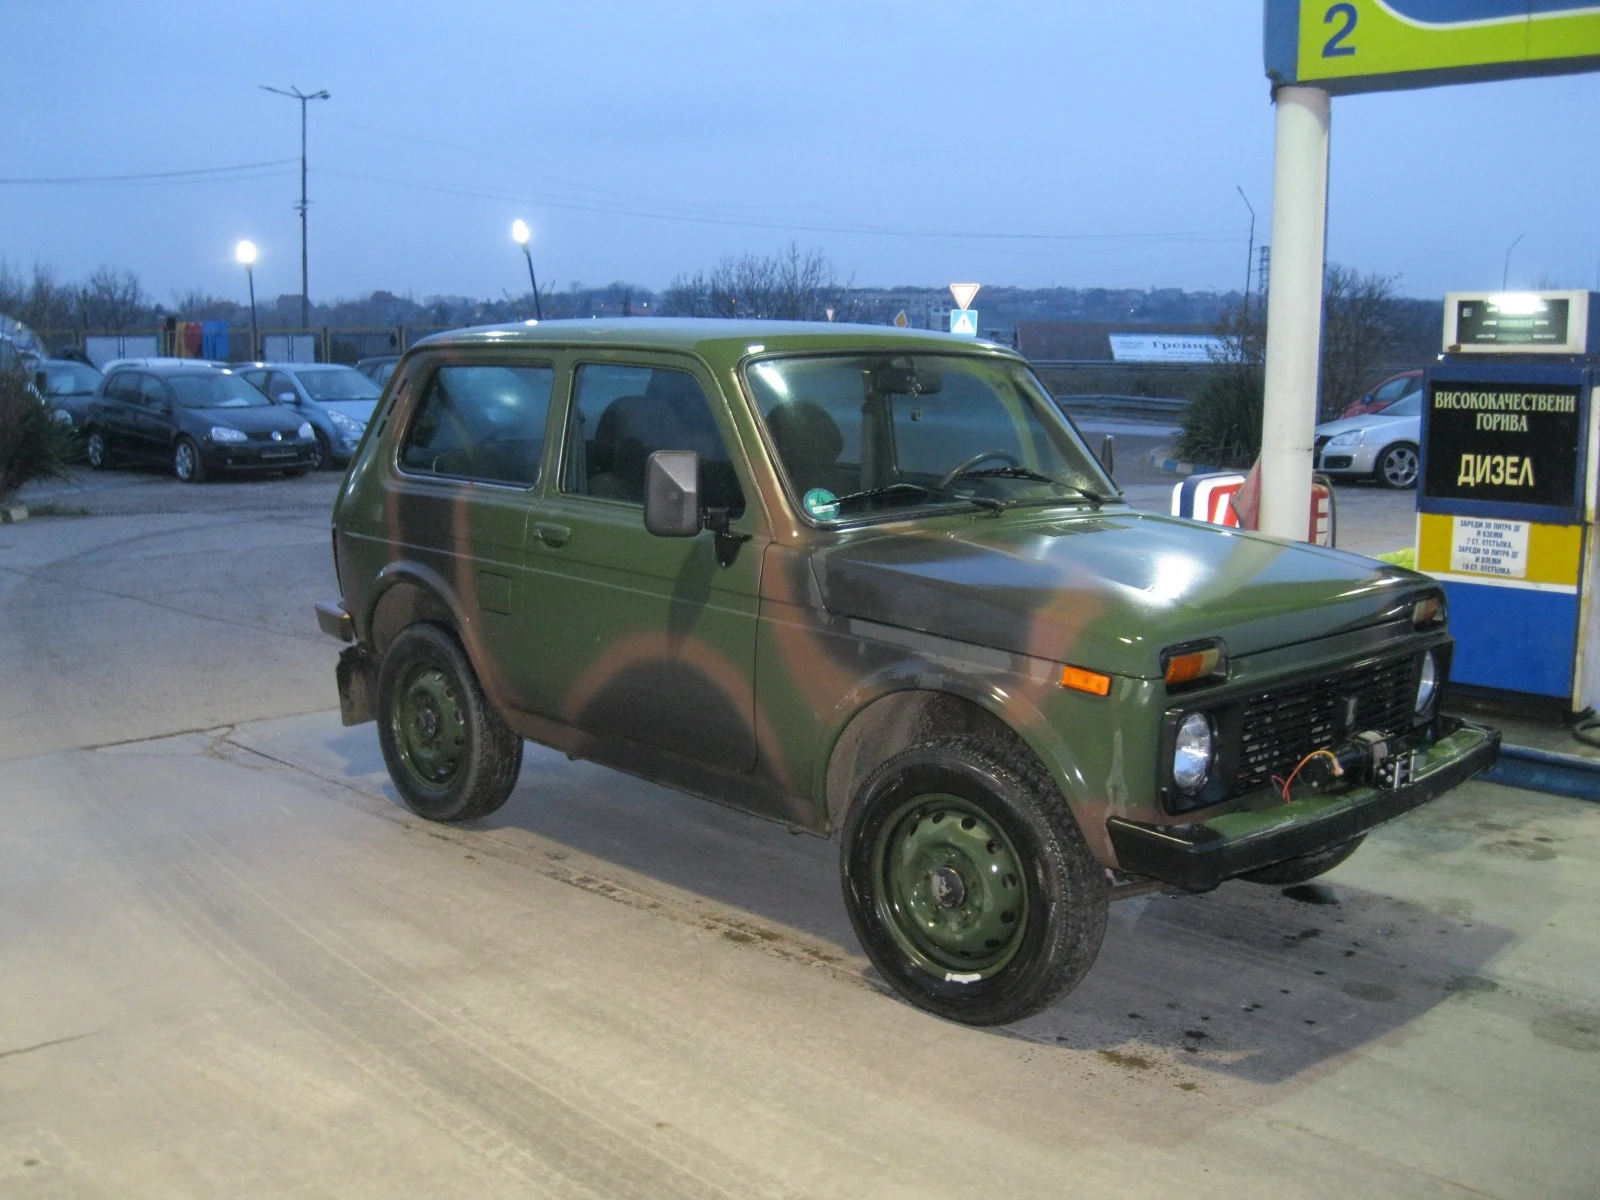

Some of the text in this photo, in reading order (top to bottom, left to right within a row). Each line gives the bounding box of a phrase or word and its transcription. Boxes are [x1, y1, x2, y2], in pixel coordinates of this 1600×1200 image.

[1321, 3, 1358, 58] 2
[1435, 391, 1575, 412] ВИСОКОКАЧЕСТВЕНИ
[1476, 413, 1528, 432] ГОРИВА
[1457, 454, 1535, 487] ДИЗЕЛ
[1460, 520, 1483, 529] ЗАРЕДИ
[1493, 523, 1512, 531] ЛИТРА
[1482, 531, 1503, 539] ВЗЕМИ
[1458, 546, 1481, 555] ЗАРЕДИ
[1491, 549, 1510, 557] ЛИТРА
[1481, 556, 1502, 565] ВЗЕМИ
